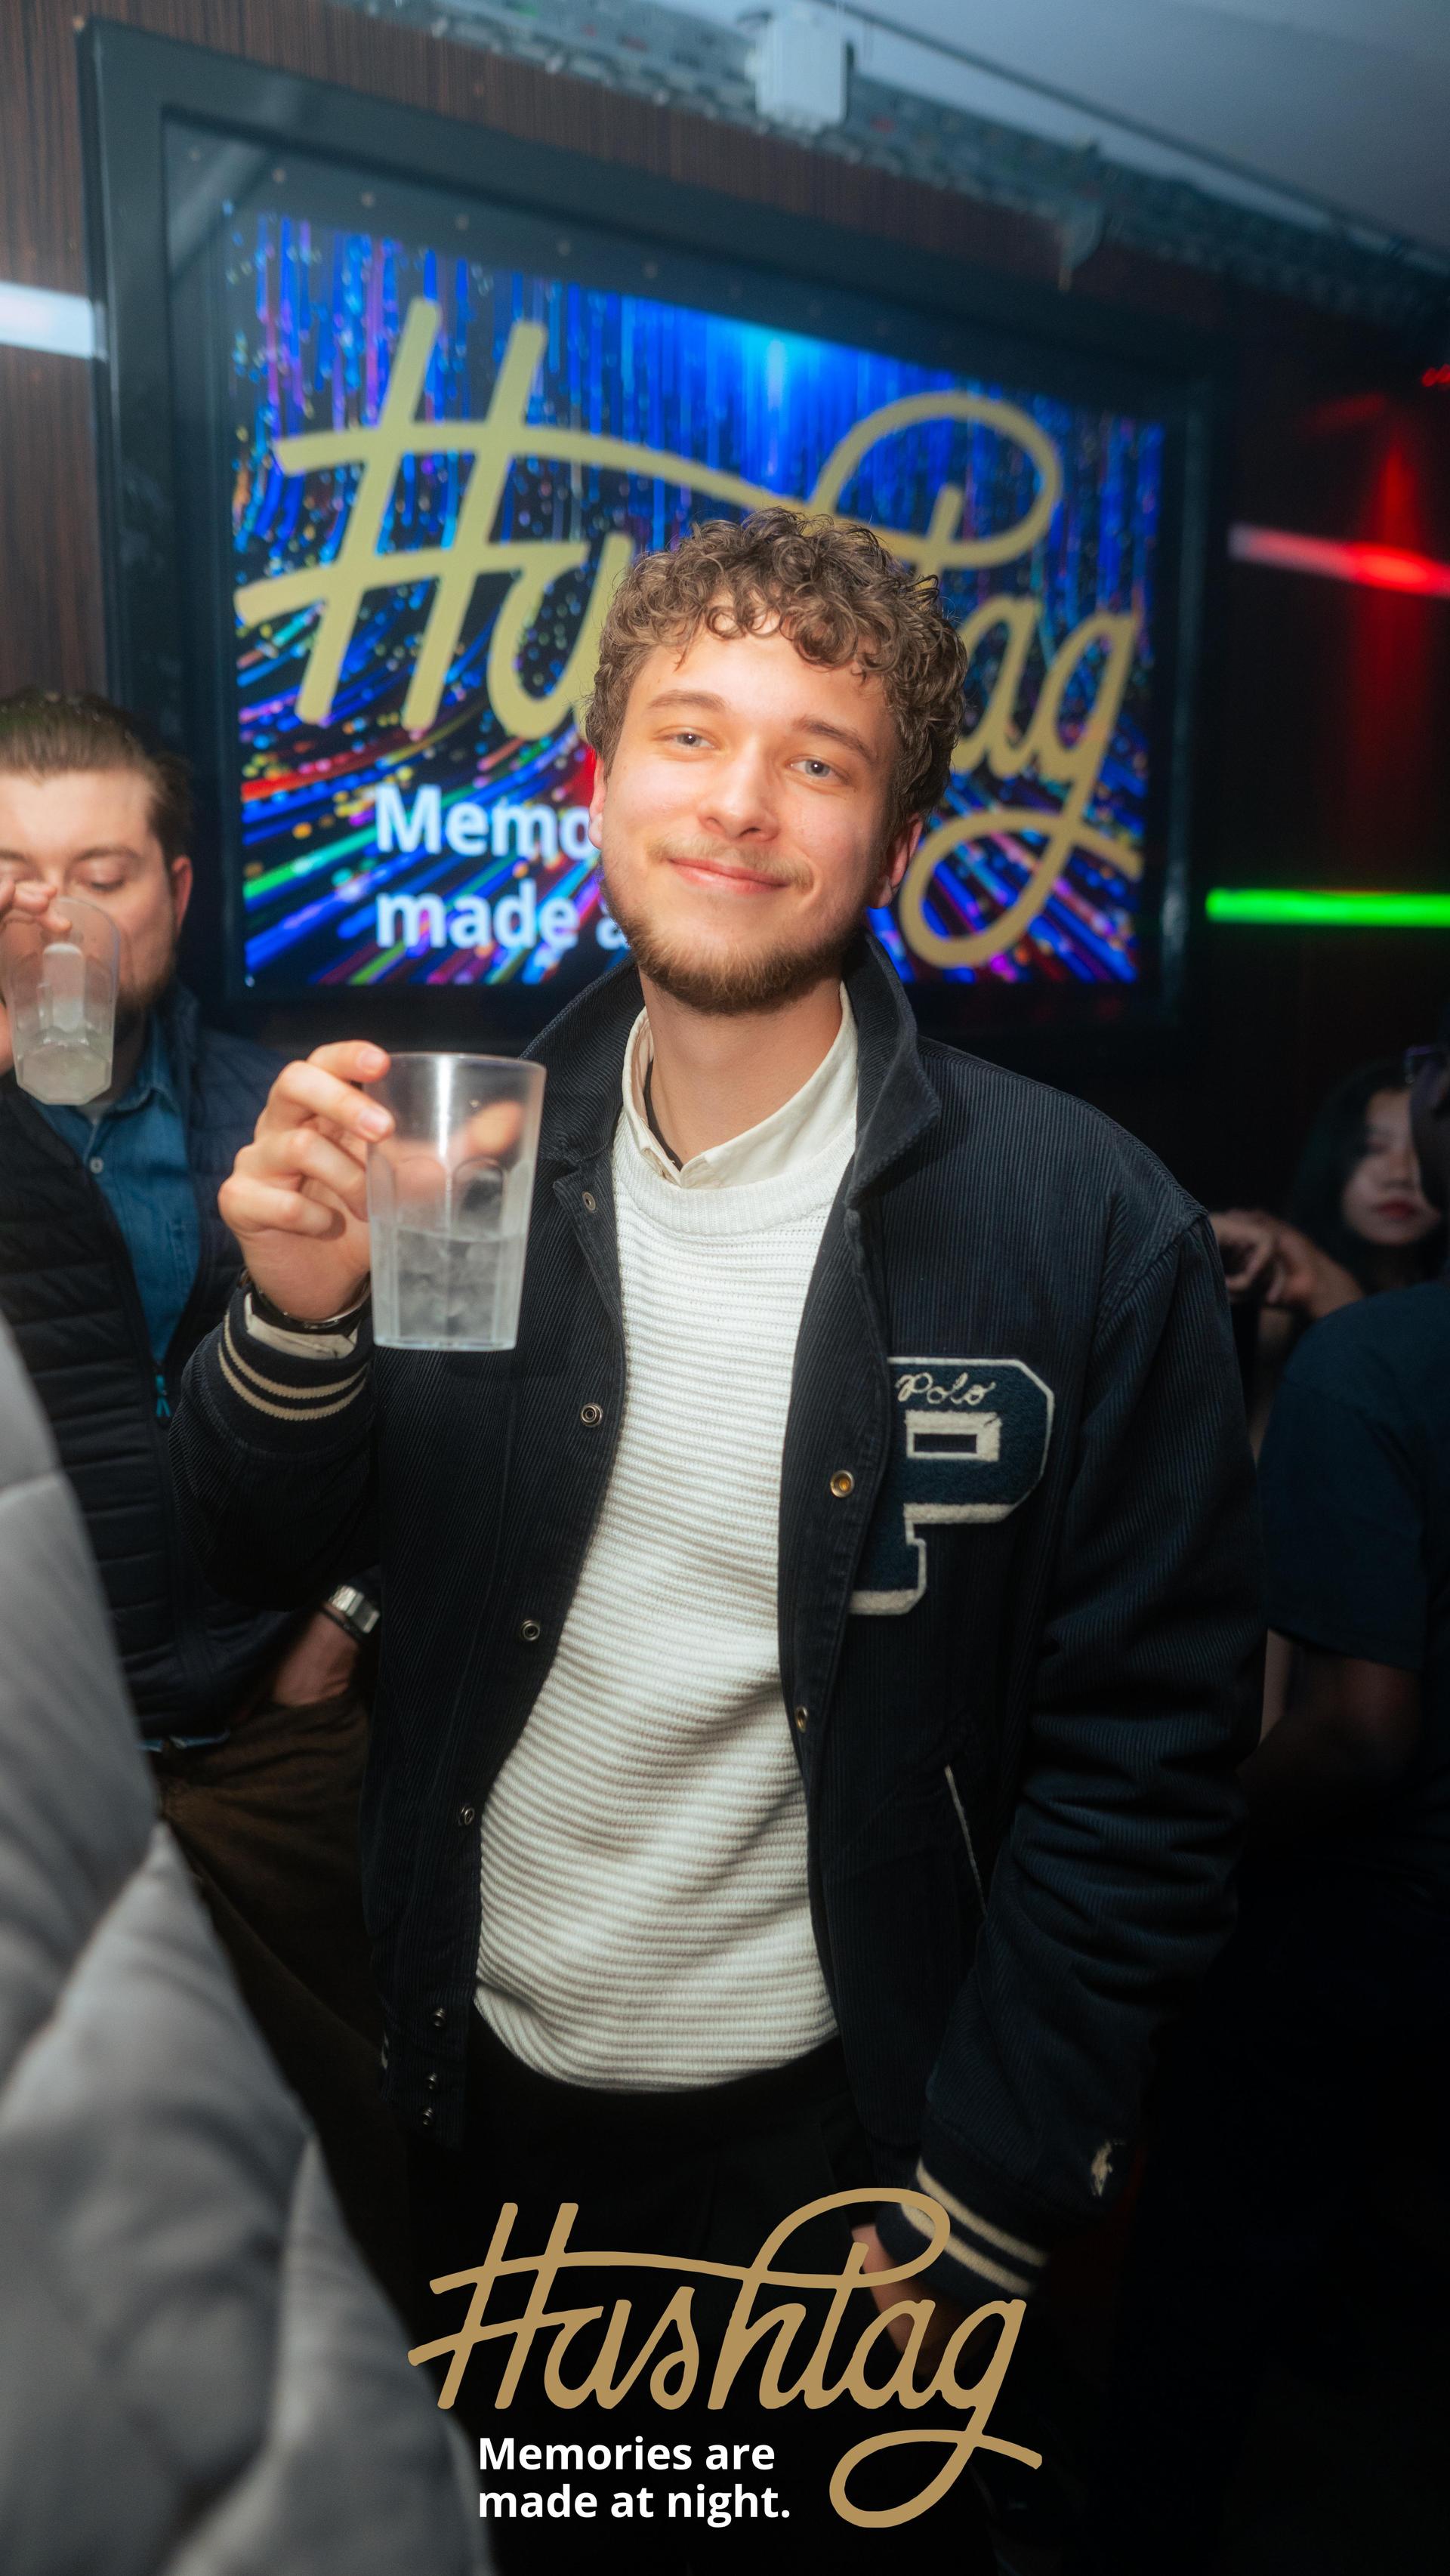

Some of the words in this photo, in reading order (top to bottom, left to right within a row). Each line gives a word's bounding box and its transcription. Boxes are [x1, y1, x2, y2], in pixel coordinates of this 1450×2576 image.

[376, 782, 602, 861] Memo
[376, 878, 580, 950] made
[894, 1371, 997, 1406] Polo
